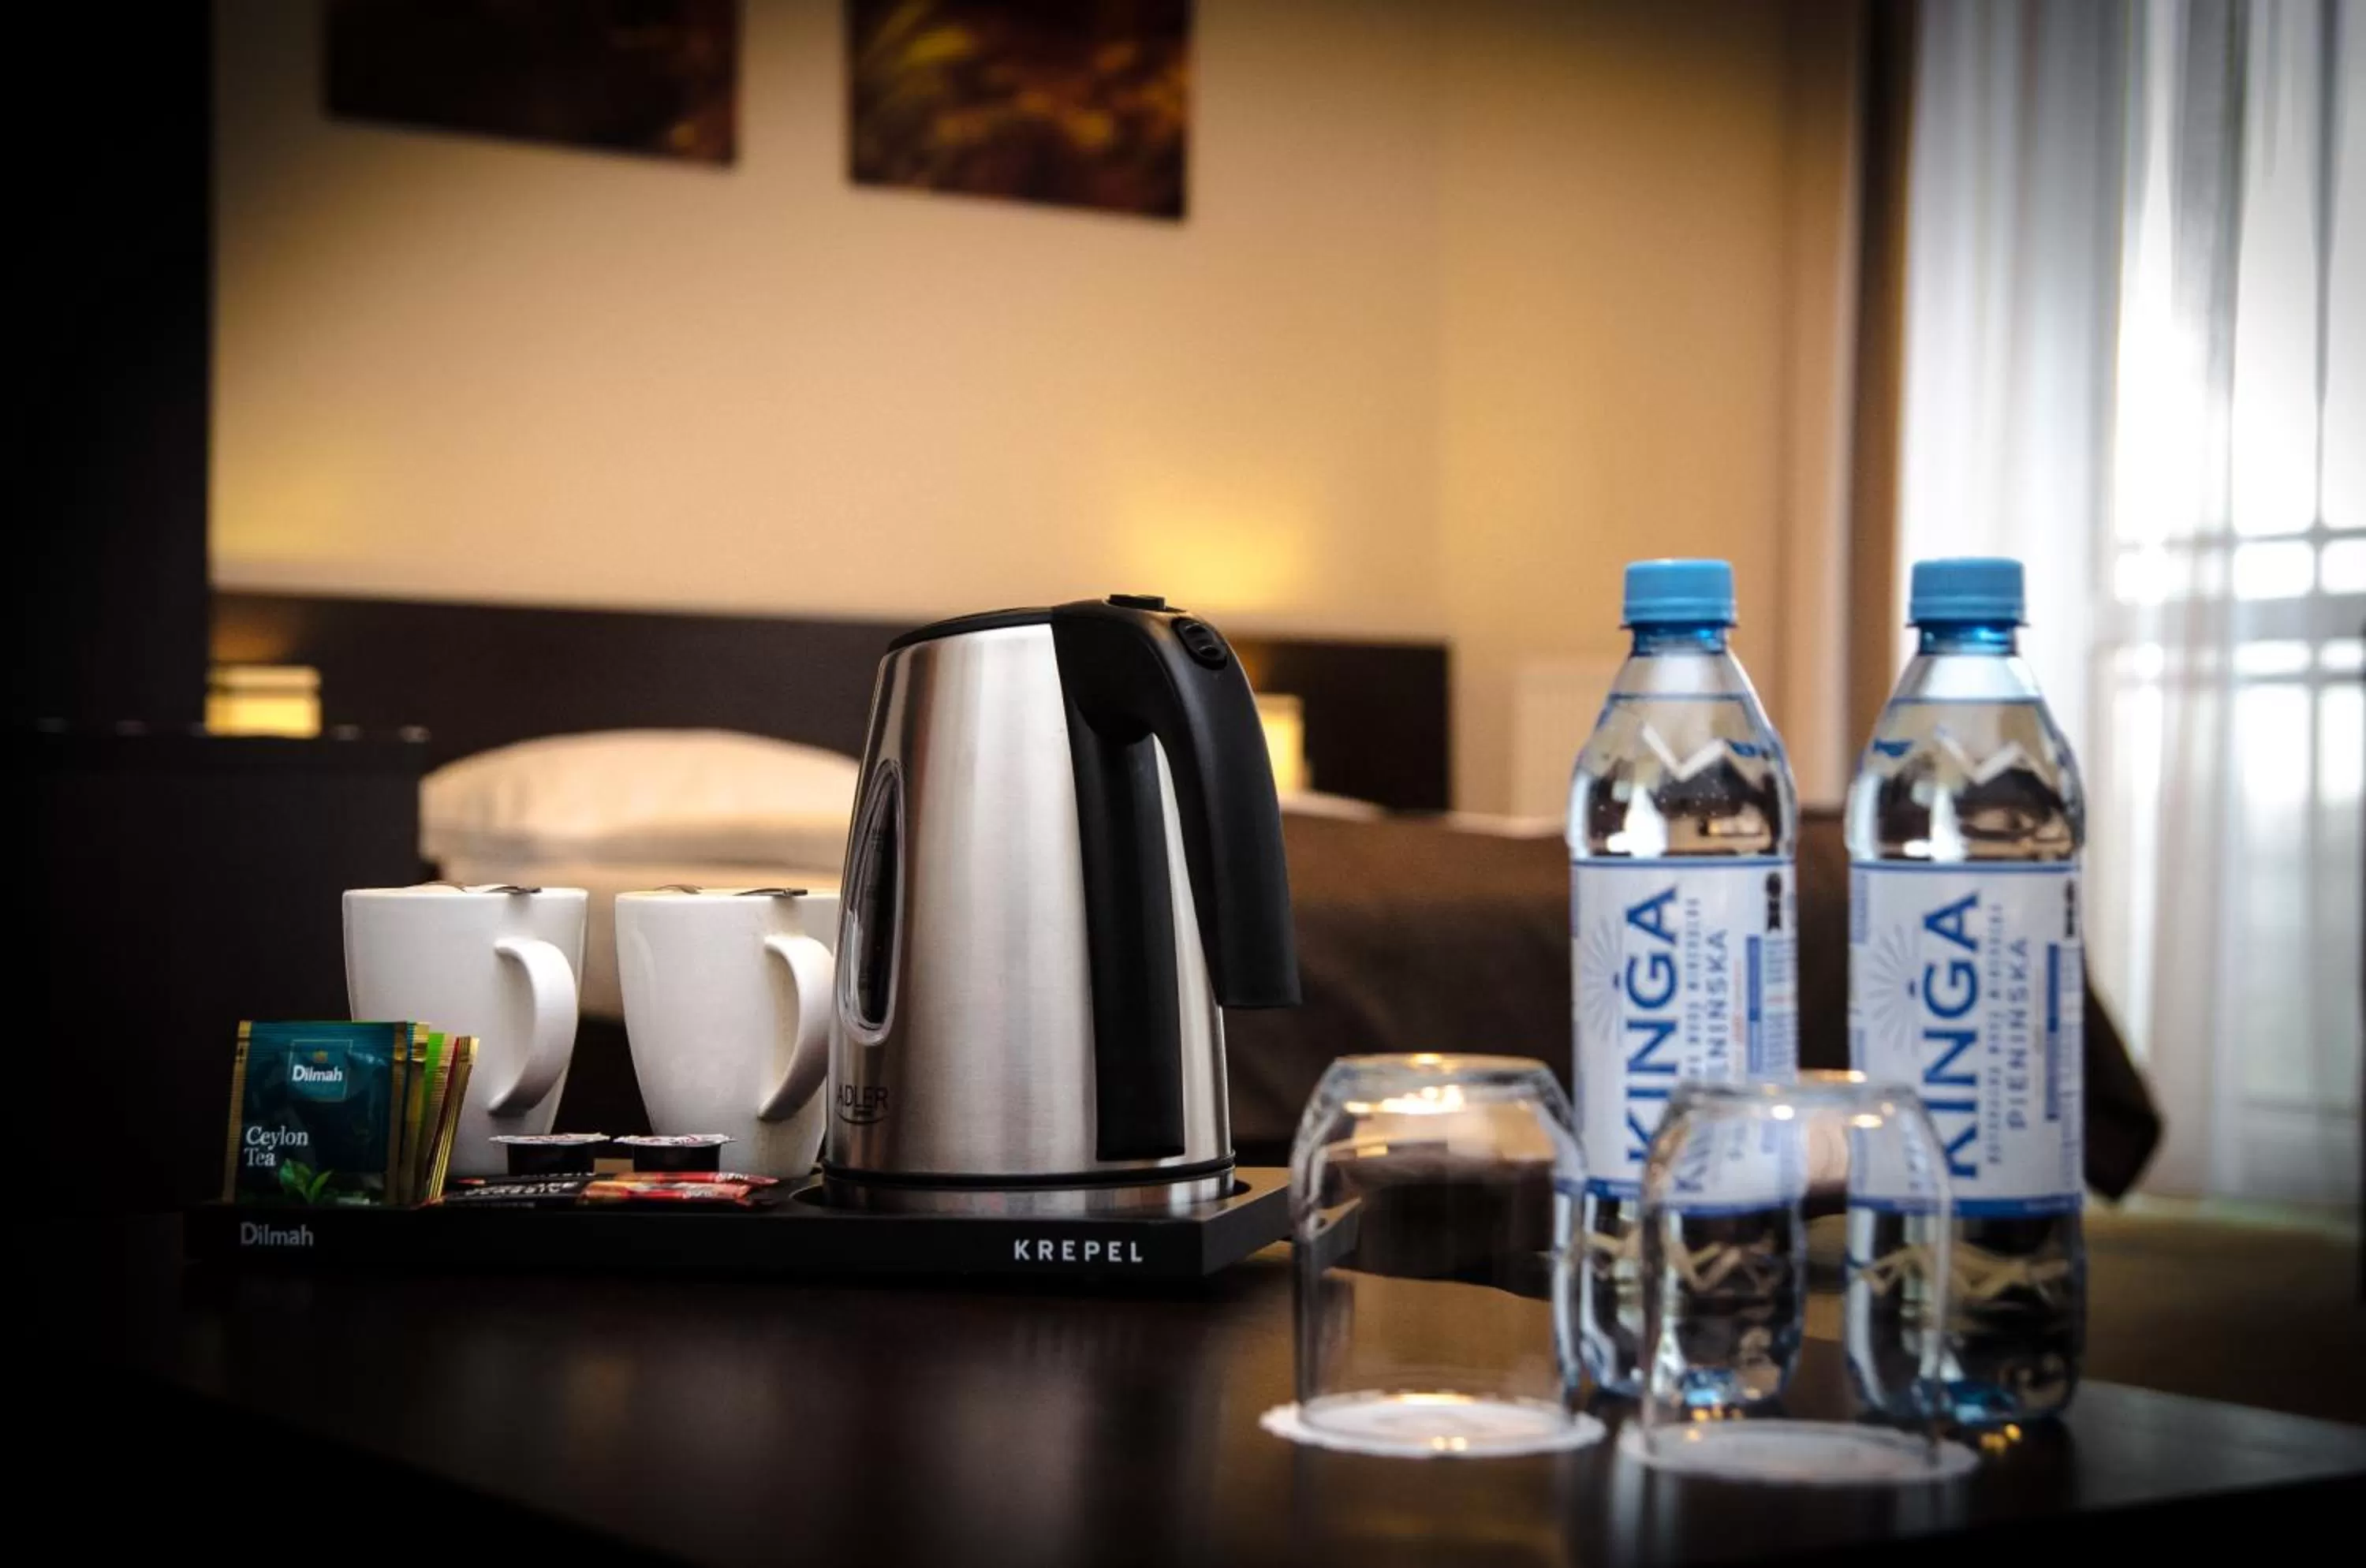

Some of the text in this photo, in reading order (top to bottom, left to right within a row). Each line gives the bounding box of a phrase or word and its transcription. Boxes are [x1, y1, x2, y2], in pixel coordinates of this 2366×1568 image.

[291, 1064, 343, 1082] Dilmah
[836, 1084, 889, 1111] ADLER
[245, 1126, 309, 1151] Ceylon
[244, 1147, 277, 1167] Tea
[240, 1222, 314, 1246] Dilmah
[1013, 1239, 1144, 1264] KREPEL
